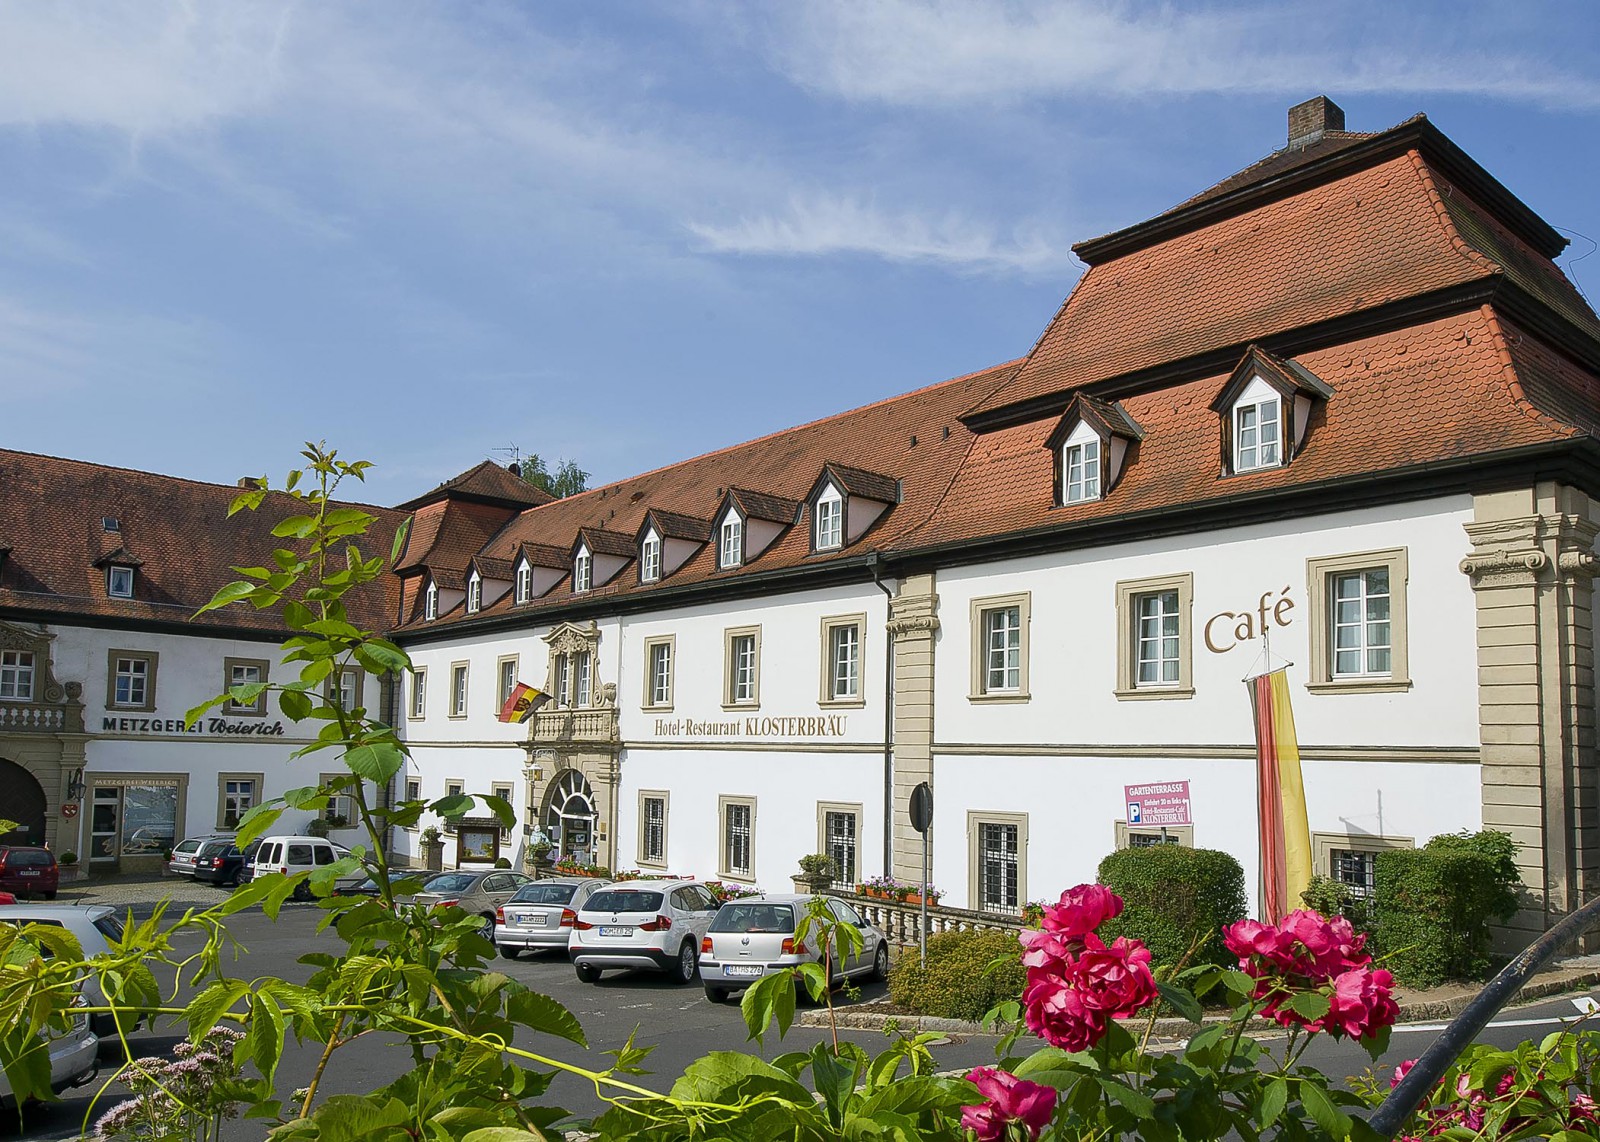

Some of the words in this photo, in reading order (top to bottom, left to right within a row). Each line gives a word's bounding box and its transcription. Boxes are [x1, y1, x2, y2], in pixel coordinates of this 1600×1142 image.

[1204, 585, 1295, 653] Café
[208, 717, 285, 736] Weierich
[654, 717, 741, 736] Hotel-Restaurant
[745, 714, 848, 737] KLOSTERBRÄU
[1129, 783, 1184, 796] GARTENTERRASSE
[1130, 804, 1140, 822] P
